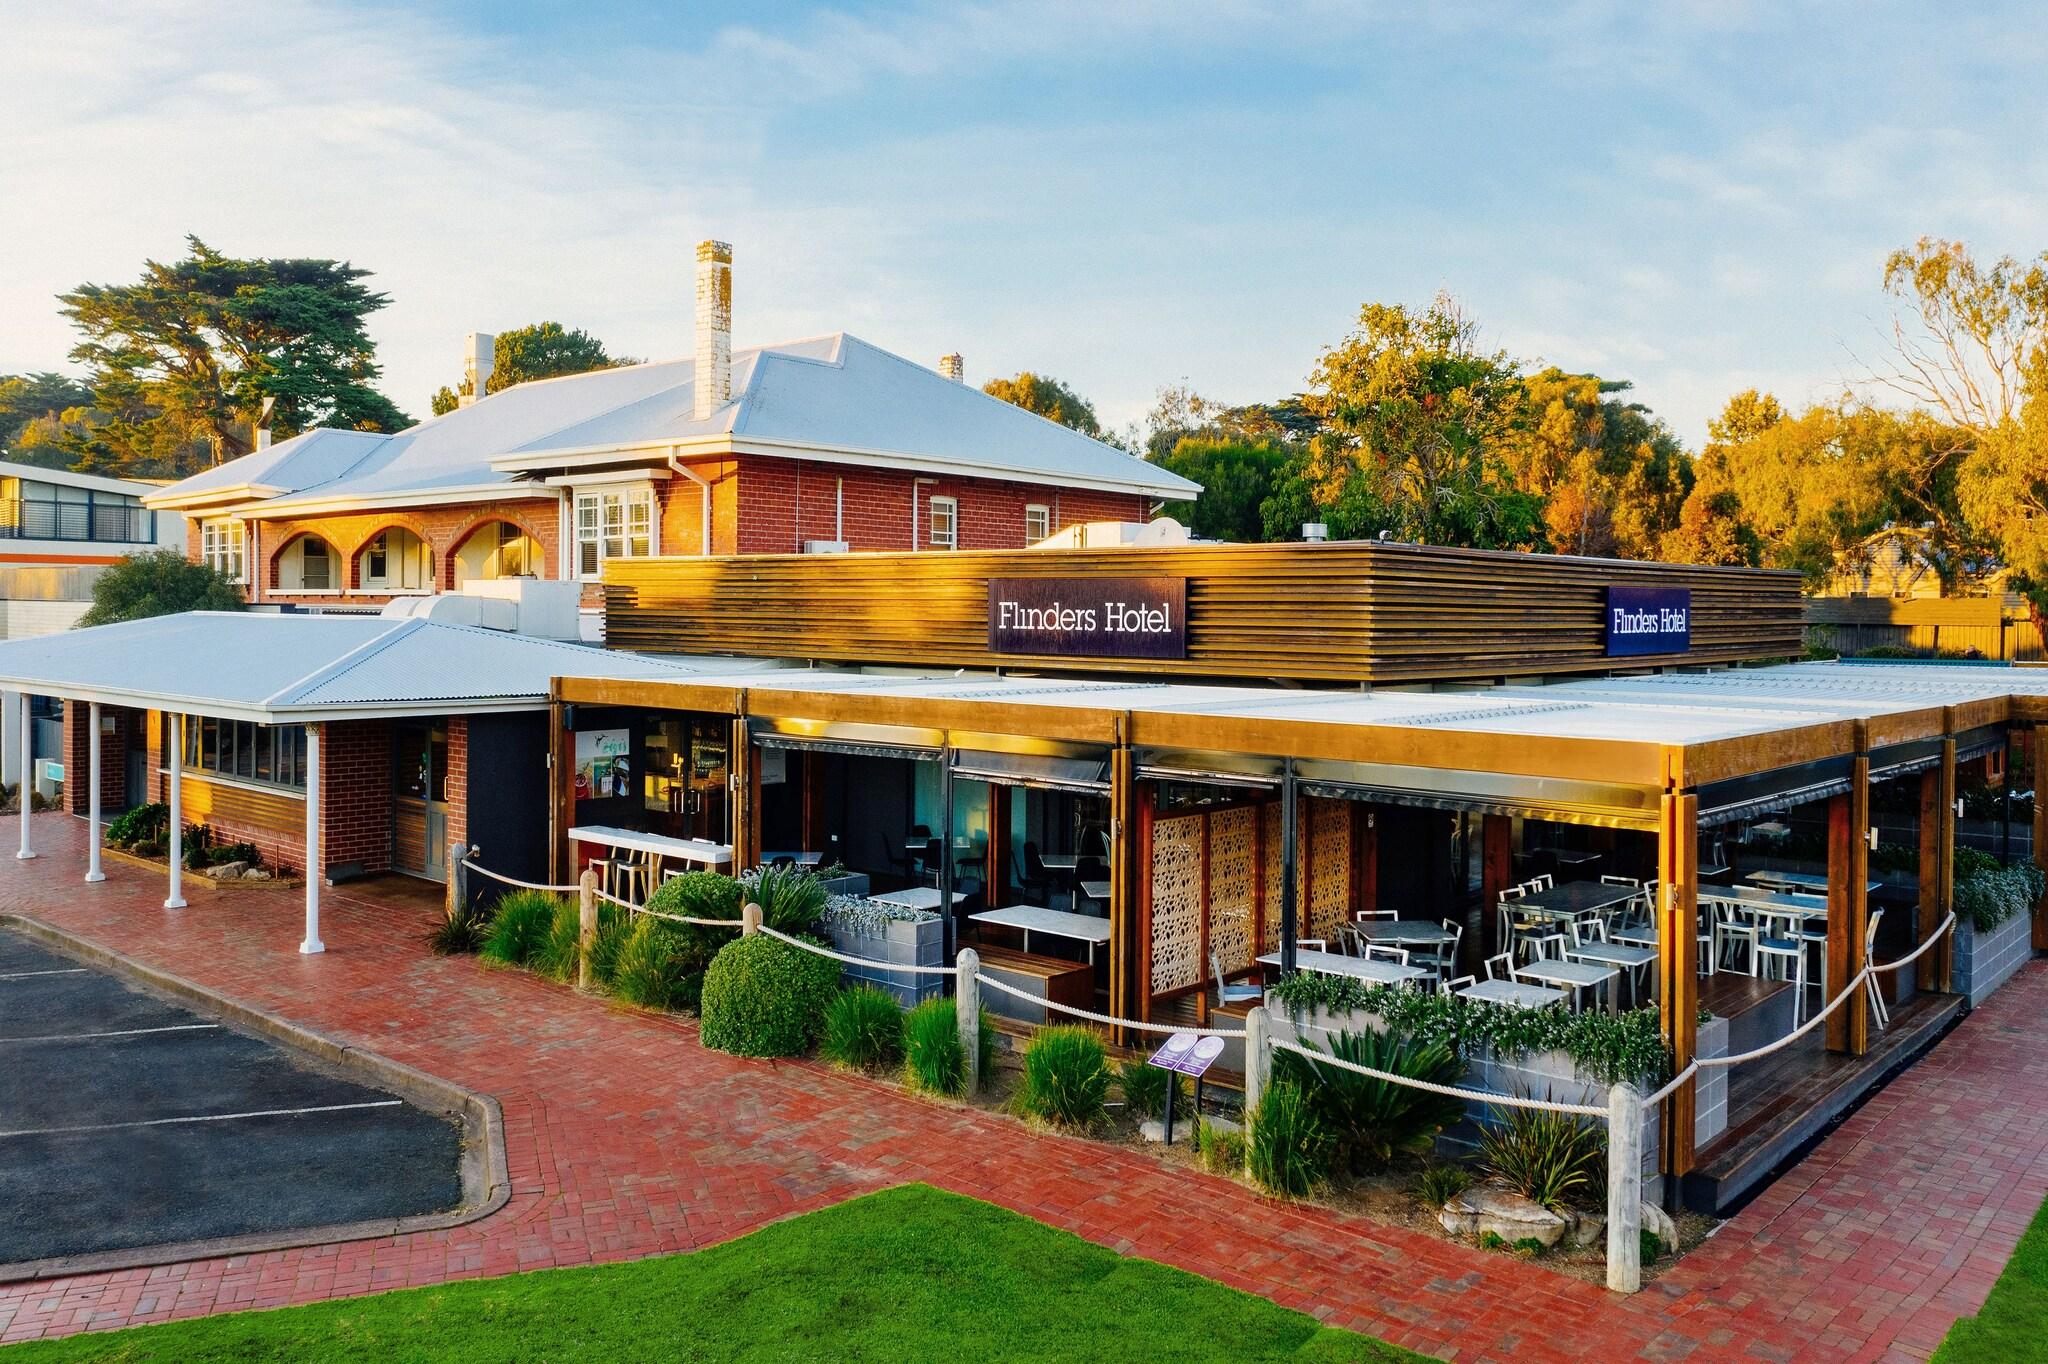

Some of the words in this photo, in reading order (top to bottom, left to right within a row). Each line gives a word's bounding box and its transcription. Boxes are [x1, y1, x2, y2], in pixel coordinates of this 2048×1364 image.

[998, 601, 1096, 632] Flinders
[1104, 602, 1171, 633] Hotel
[1613, 608, 1658, 634] Flinders
[1660, 608, 1687, 633] Hotel
